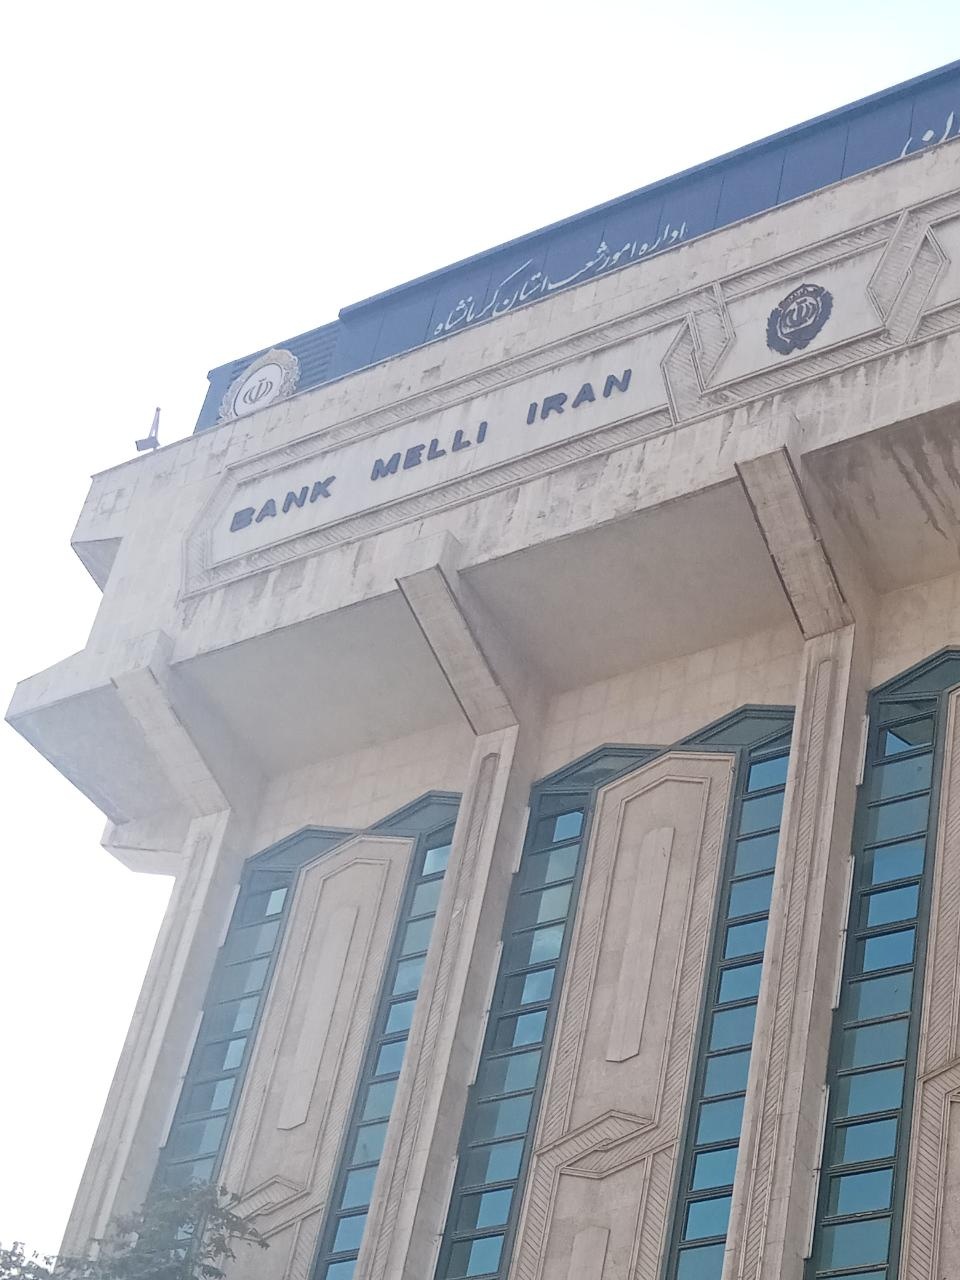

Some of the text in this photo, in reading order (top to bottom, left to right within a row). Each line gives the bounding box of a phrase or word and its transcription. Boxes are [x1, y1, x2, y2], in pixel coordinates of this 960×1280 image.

[229, 368, 633, 533] BANK MELLI IRAN
